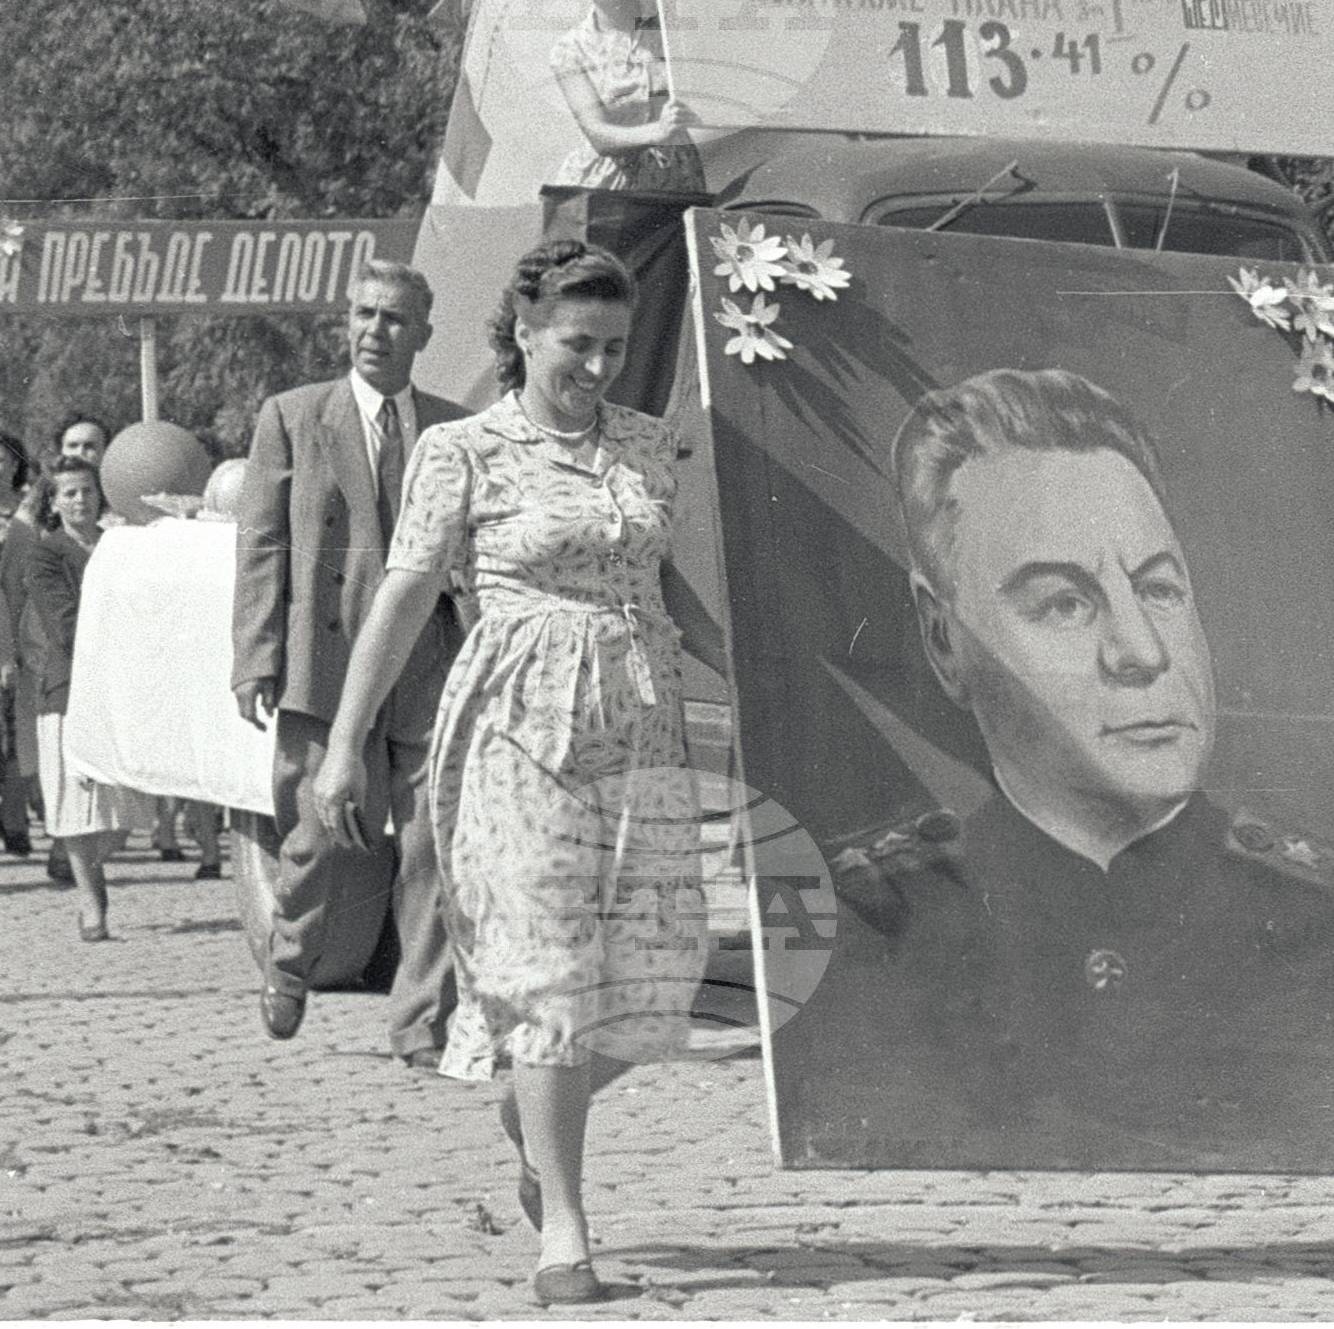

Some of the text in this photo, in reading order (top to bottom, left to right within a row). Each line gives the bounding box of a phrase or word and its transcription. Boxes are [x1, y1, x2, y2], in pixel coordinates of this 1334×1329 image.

[1131, 40, 1212, 124] %
[37, 230, 214, 304] ПРЕБЪДЕ
[220, 230, 377, 304] ДЕЛОТО
